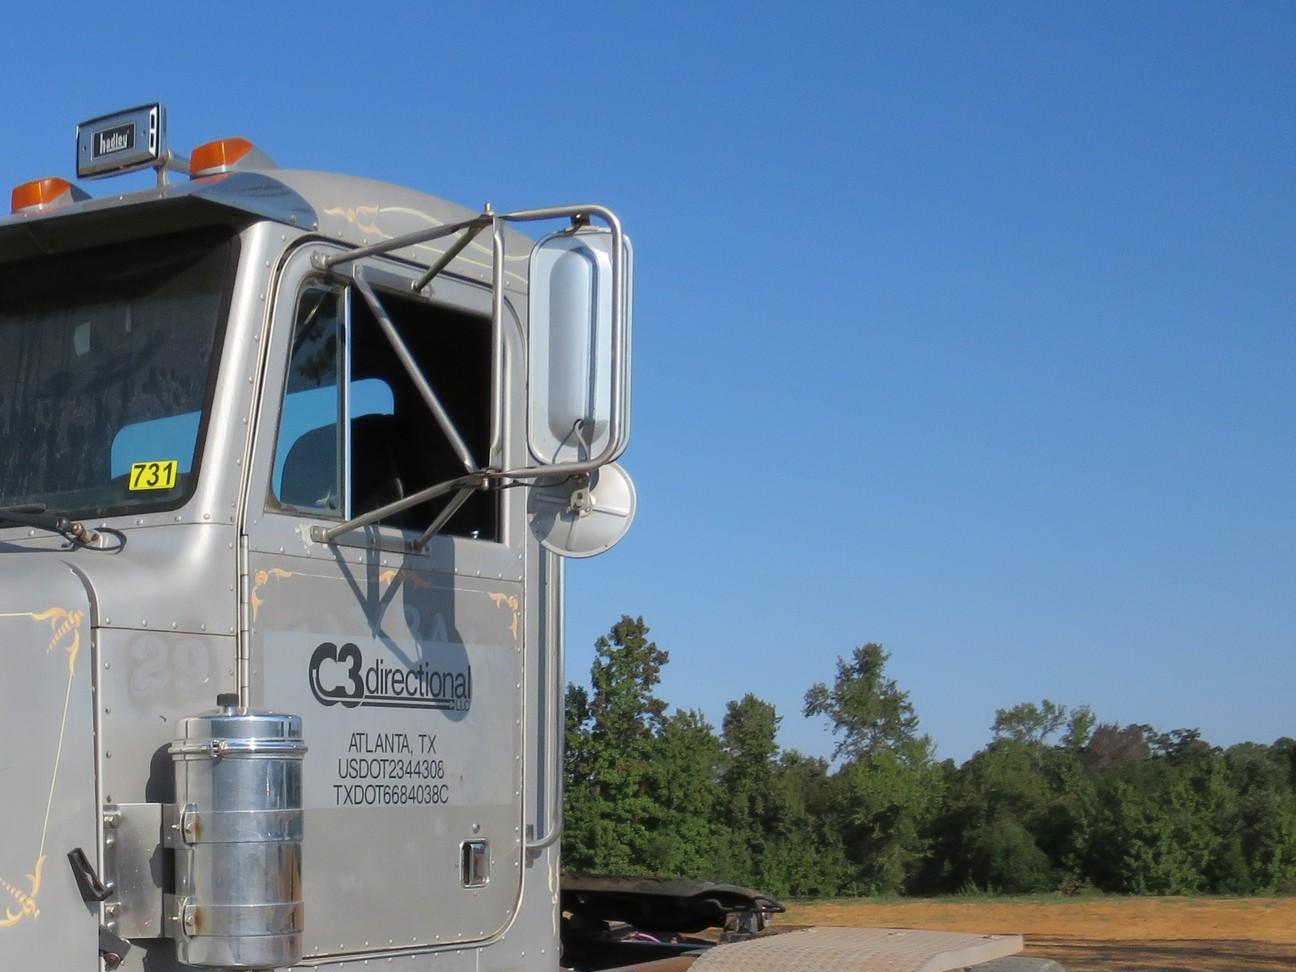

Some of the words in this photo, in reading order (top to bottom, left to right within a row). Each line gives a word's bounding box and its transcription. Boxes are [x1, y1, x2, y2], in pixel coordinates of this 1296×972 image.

[99, 132, 128, 154] hadley
[134, 462, 172, 487] 731
[309, 642, 364, 708] C3
[365, 658, 472, 699] directional
[348, 732, 413, 755] ATLANTA,
[418, 734, 437, 753] TX
[338, 758, 445, 779] USDOT2344308
[333, 784, 449, 805] TXDOT6684038C
